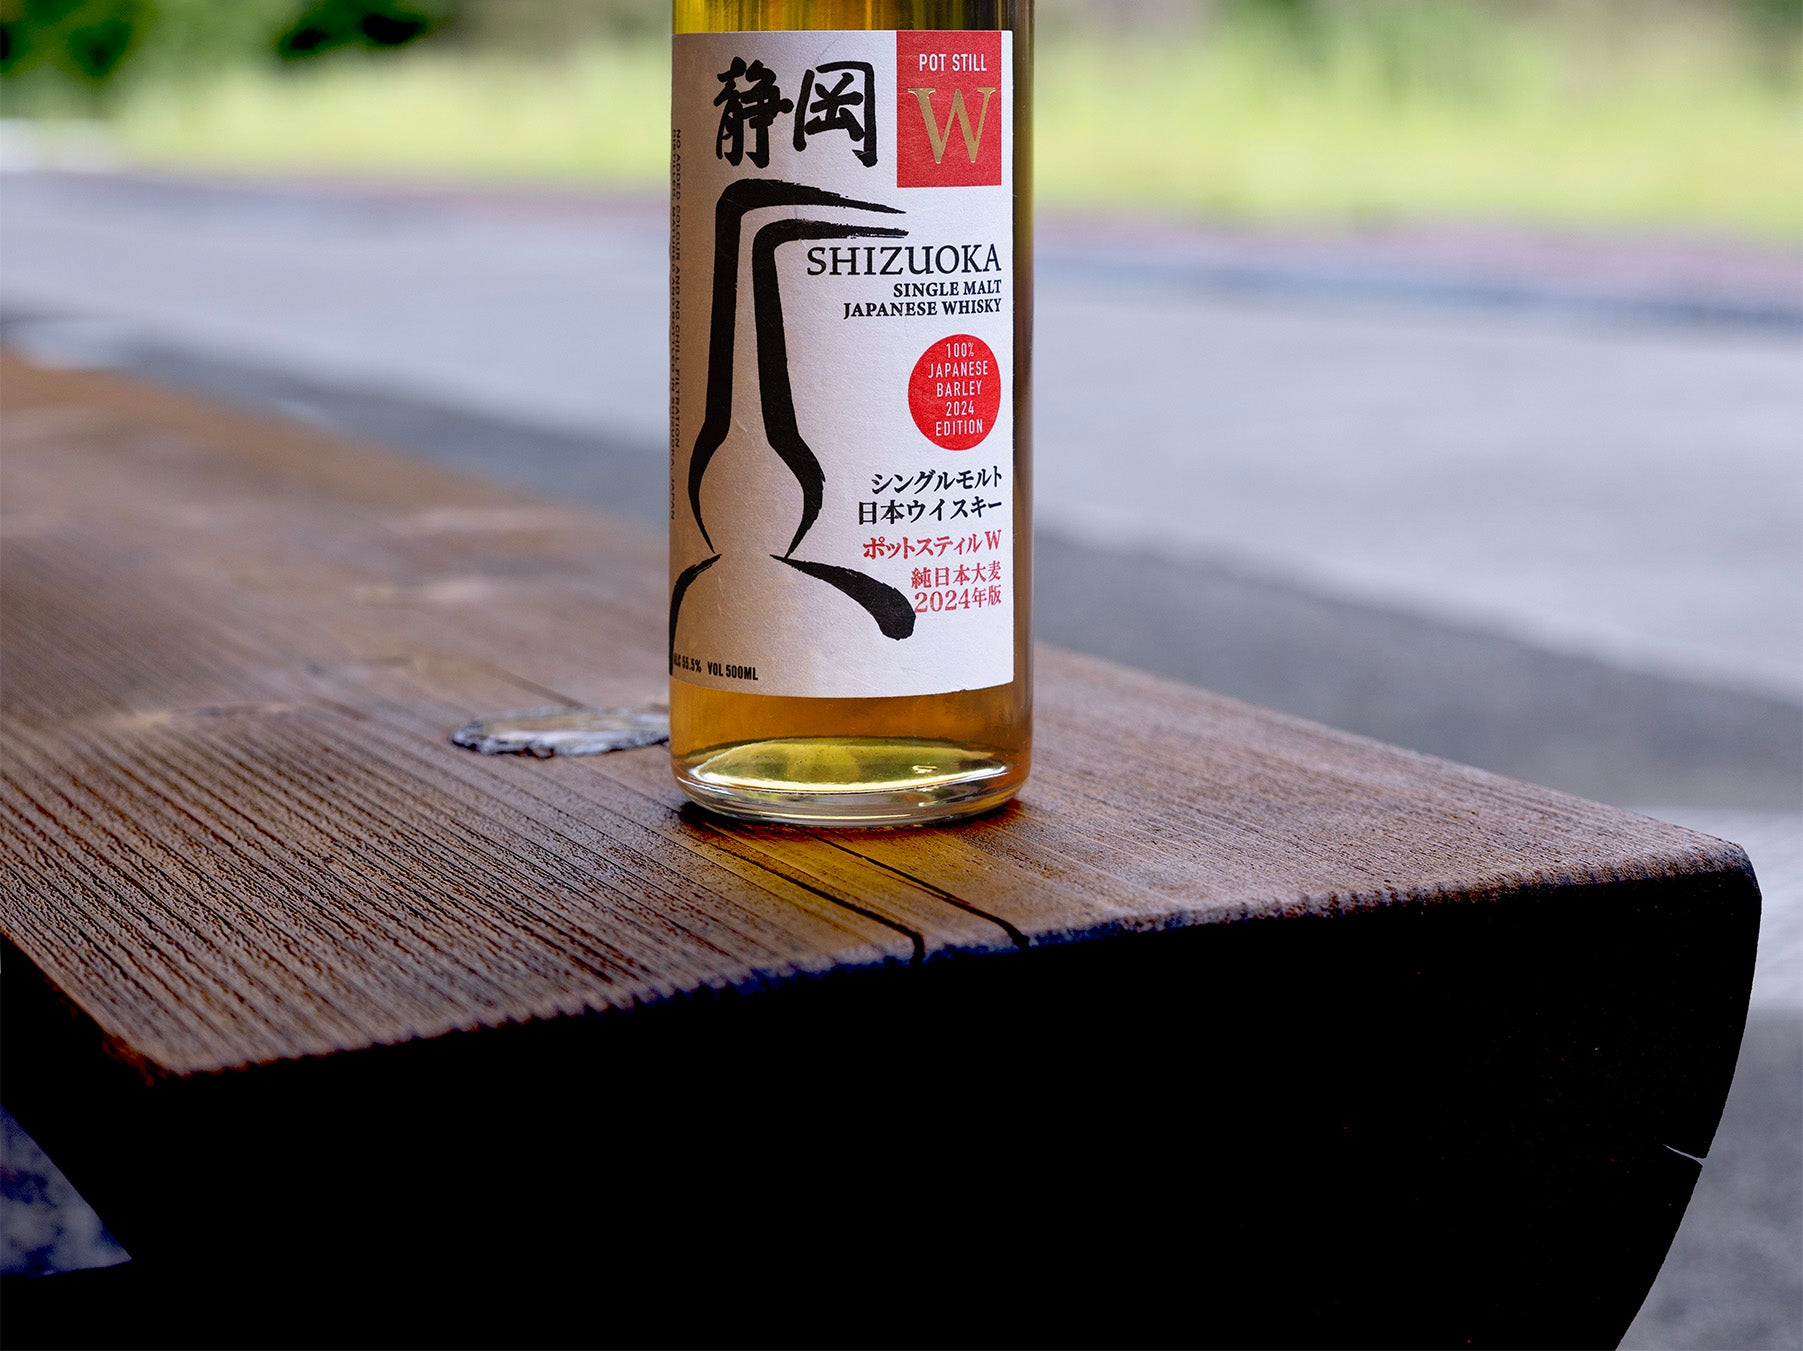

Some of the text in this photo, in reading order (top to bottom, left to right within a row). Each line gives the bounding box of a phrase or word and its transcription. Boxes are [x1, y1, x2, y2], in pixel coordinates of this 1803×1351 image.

[919, 53, 987, 72] POT STILL
[713, 56, 878, 168] 静岡
[907, 87, 996, 164] W
[807, 244, 1001, 276] SHIZUOKA
[893, 280, 1001, 297] SINGLE MALT
[844, 298, 1001, 320] JAPANESE WHISKY
[946, 342, 974, 358] 100%
[928, 360, 988, 378] JAPANESE
[936, 380, 982, 397] BARLEY
[946, 400, 974, 416] 2024
[936, 419, 983, 436] EDITION
[871, 465, 1002, 495] シングルモルト
[858, 496, 1002, 525] 日本ウイスキー
[863, 529, 1002, 560] ポットスティル W
[911, 560, 1001, 589] 純日本大麦
[914, 584, 1002, 614] 2024年版
[707, 661, 723, 677] VOL
[725, 664, 758, 681] 500ML
